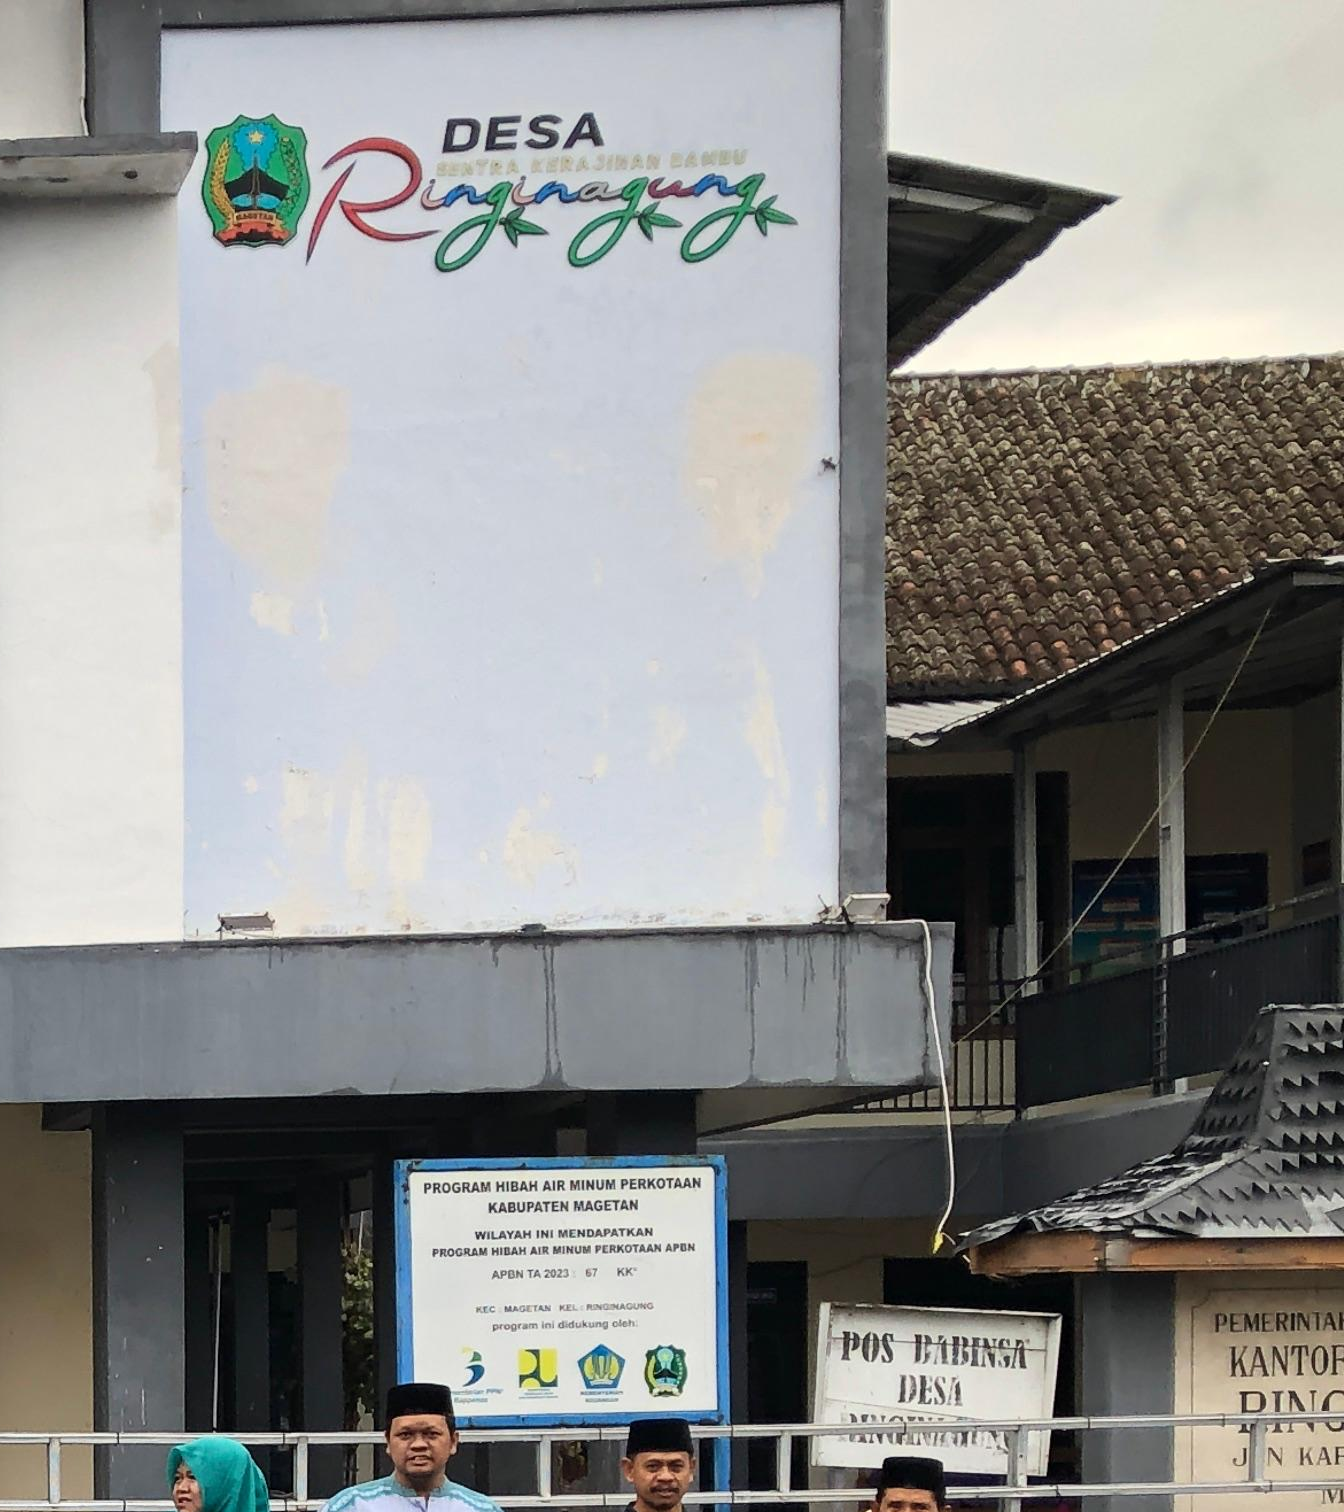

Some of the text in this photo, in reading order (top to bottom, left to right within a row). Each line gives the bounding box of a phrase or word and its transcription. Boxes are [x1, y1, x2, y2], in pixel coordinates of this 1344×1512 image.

[442, 113, 605, 153] DESA
[305, 136, 767, 273] Ringinagung
[424, 1177, 702, 1194] PROGRAM HIBAH AIR MINUM PERKOTAAN
[488, 1199, 639, 1214] KABUPATEN MAGETAN
[475, 1227, 653, 1240] WILAYAH INI MENDAPATKAN
[432, 1242, 696, 1258] PROGRAM HIBAH AIR MINUM PERKOTAAN APBN
[491, 1269, 524, 1280] APBN
[527, 1269, 542, 1279] TA
[544, 1268, 570, 1279] 2023
[475, 1305, 496, 1314] KEC
[504, 1304, 552, 1313] MAGETAN
[559, 1303, 578, 1312] KEL
[586, 1302, 655, 1312] RINGINAGUNG
[492, 1321, 539, 1332] program
[542, 1319, 555, 1330] ini
[557, 1318, 609, 1331] didukung
[840, 1330, 1028, 1370] POS BABINSA
[897, 1374, 964, 1407] DESA
[1232, 1446, 1284, 1467] JN
